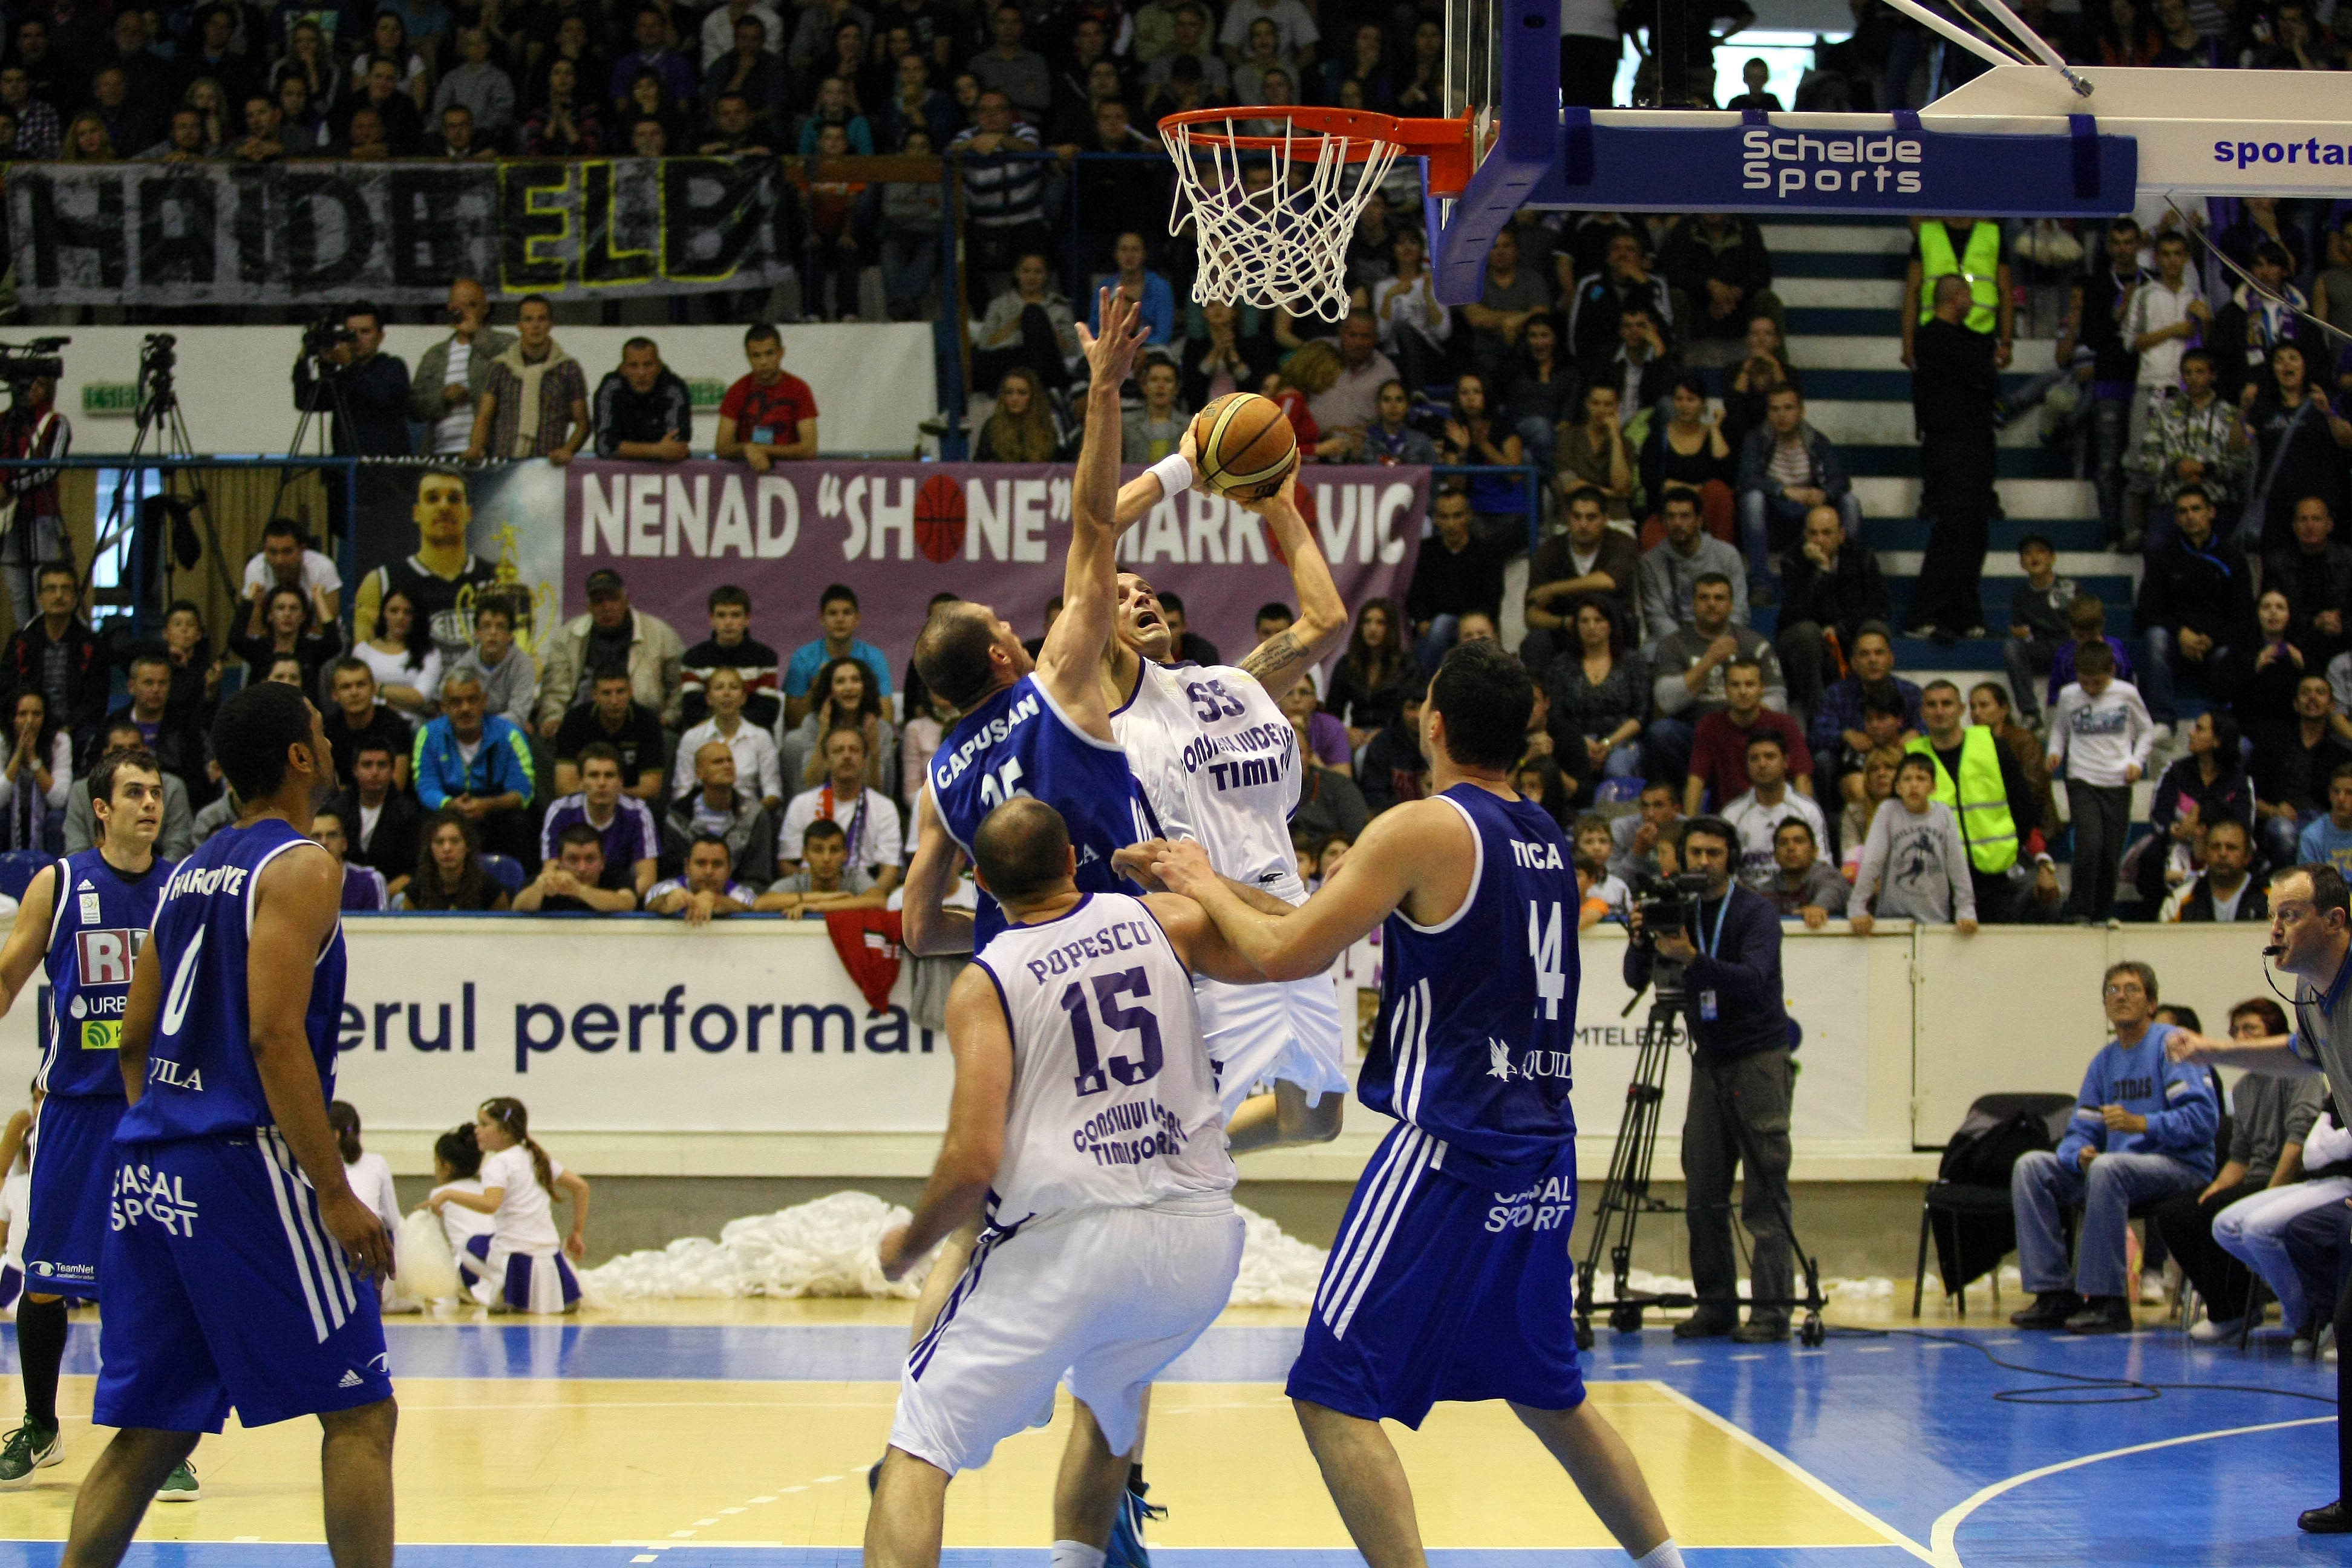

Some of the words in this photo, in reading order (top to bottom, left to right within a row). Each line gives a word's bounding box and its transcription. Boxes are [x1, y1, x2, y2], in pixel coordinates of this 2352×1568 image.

[1743, 131, 1922, 163] Schelde
[1743, 162, 1922, 198] Sports
[581, 472, 800, 558] NENAD
[1186, 679, 1245, 723] 55
[936, 693, 1040, 789] CAPUSAN
[1510, 838, 1564, 869] TICA
[1027, 921, 1152, 985] POPESCU
[162, 923, 206, 1036] 0
[90, 996, 128, 1013] URB
[337, 981, 475, 1051] erul
[515, 984, 933, 1073] performa
[1060, 965, 1163, 1097] 15
[111, 1196, 199, 1238] SPORT
[1484, 1203, 1571, 1233] SPORT
[55, 1262, 94, 1273] TeamNet
